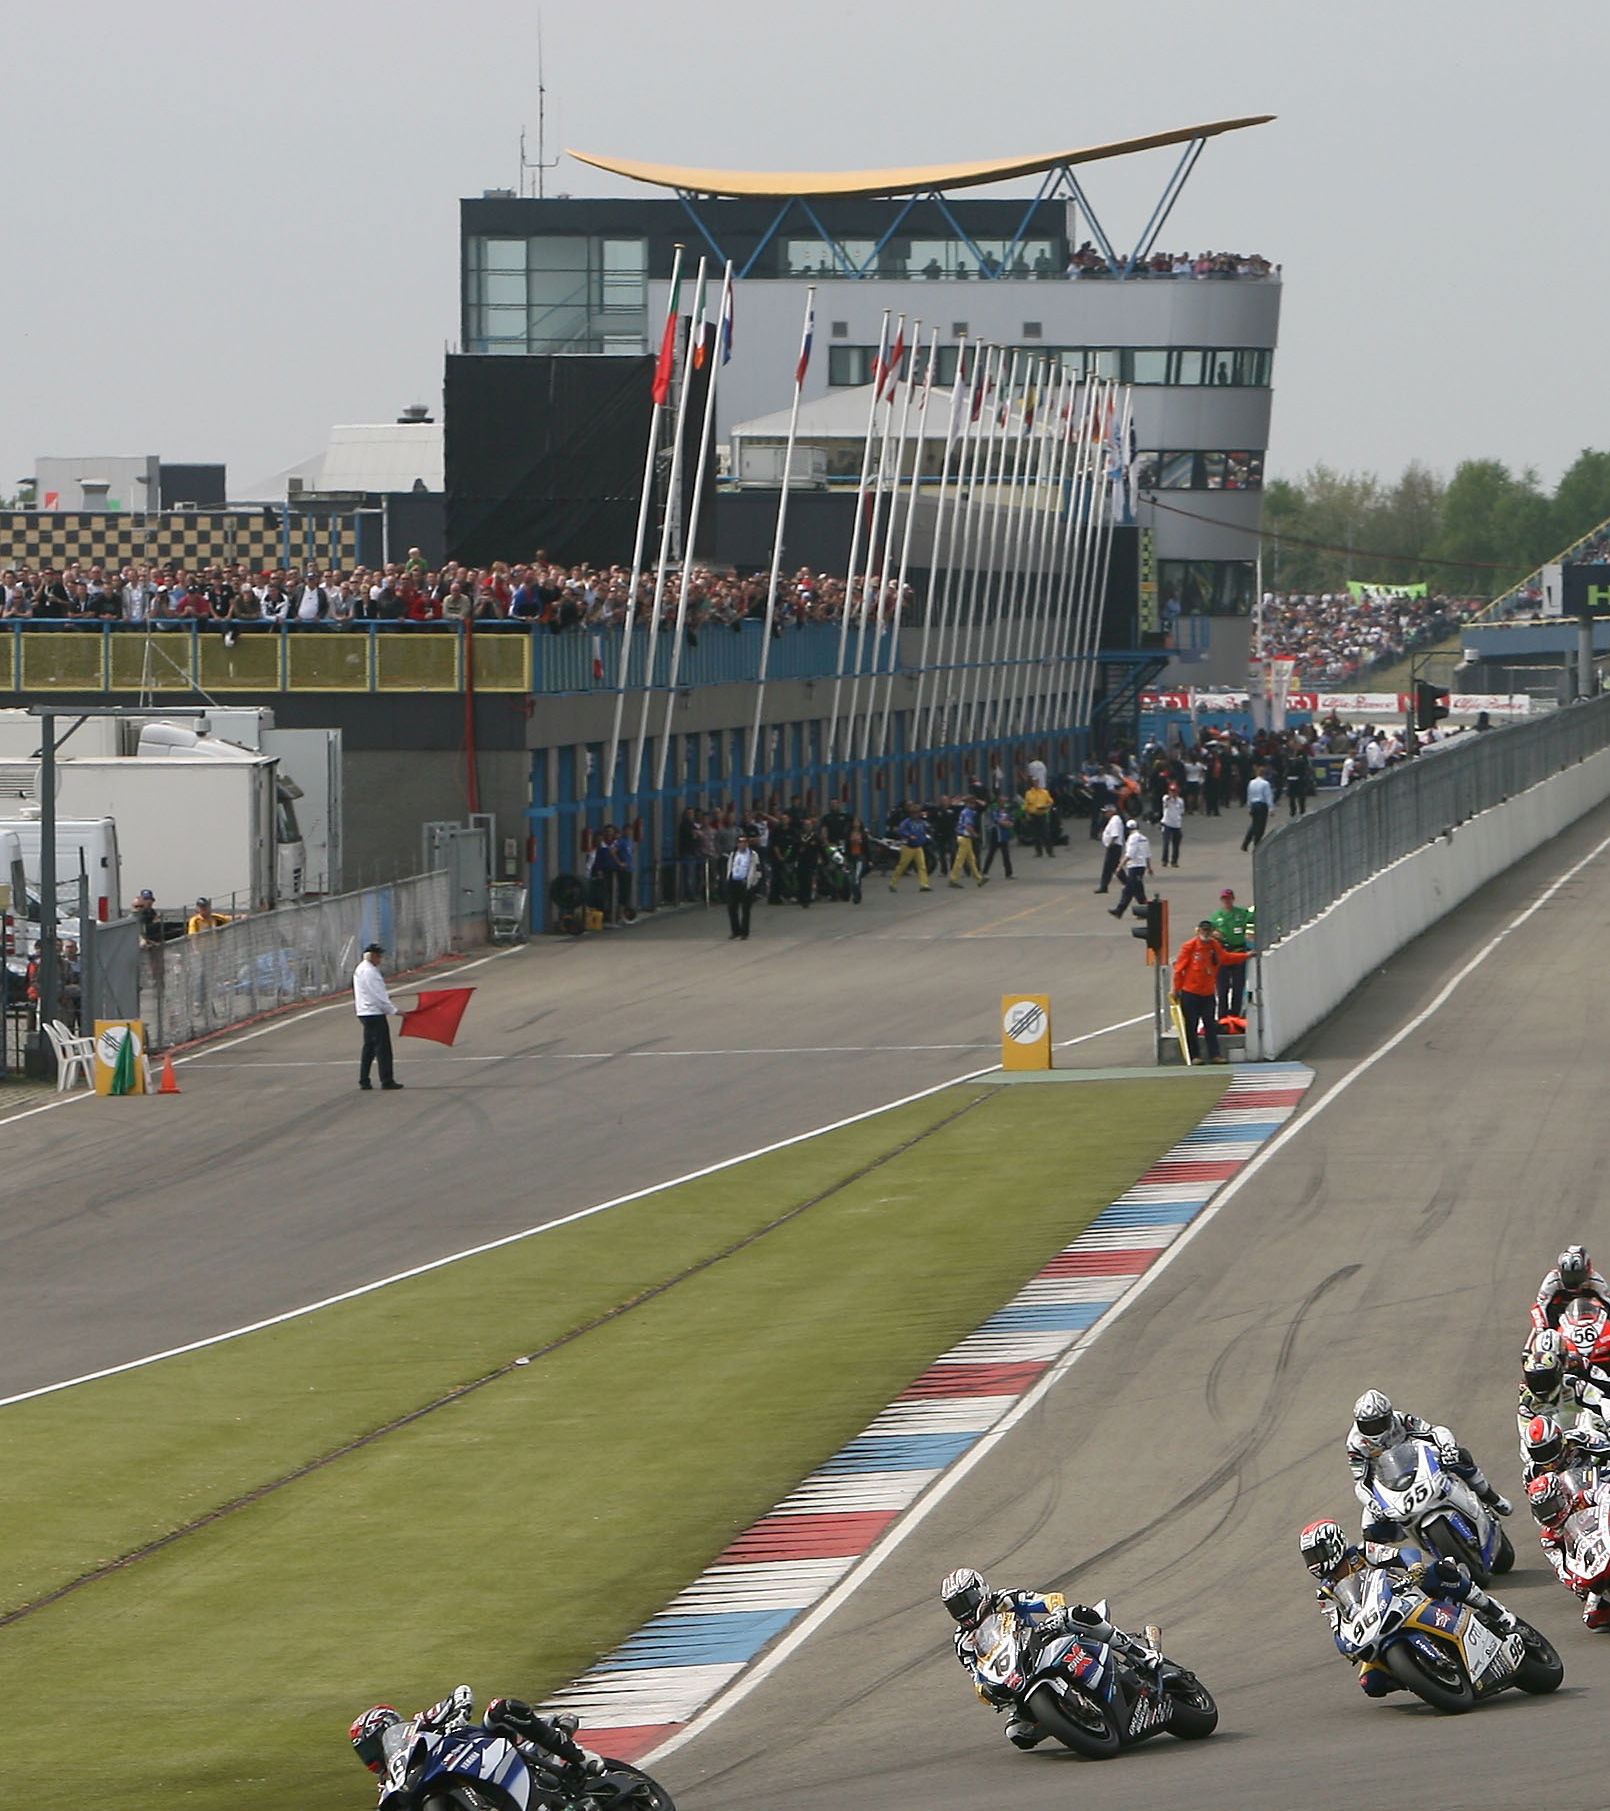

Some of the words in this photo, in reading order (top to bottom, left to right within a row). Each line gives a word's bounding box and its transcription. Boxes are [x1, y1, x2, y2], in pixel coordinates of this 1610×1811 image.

[1573, 1327, 1597, 1345] 56
[1402, 1484, 1428, 1515] 55
[1353, 1609, 1379, 1644] 96
